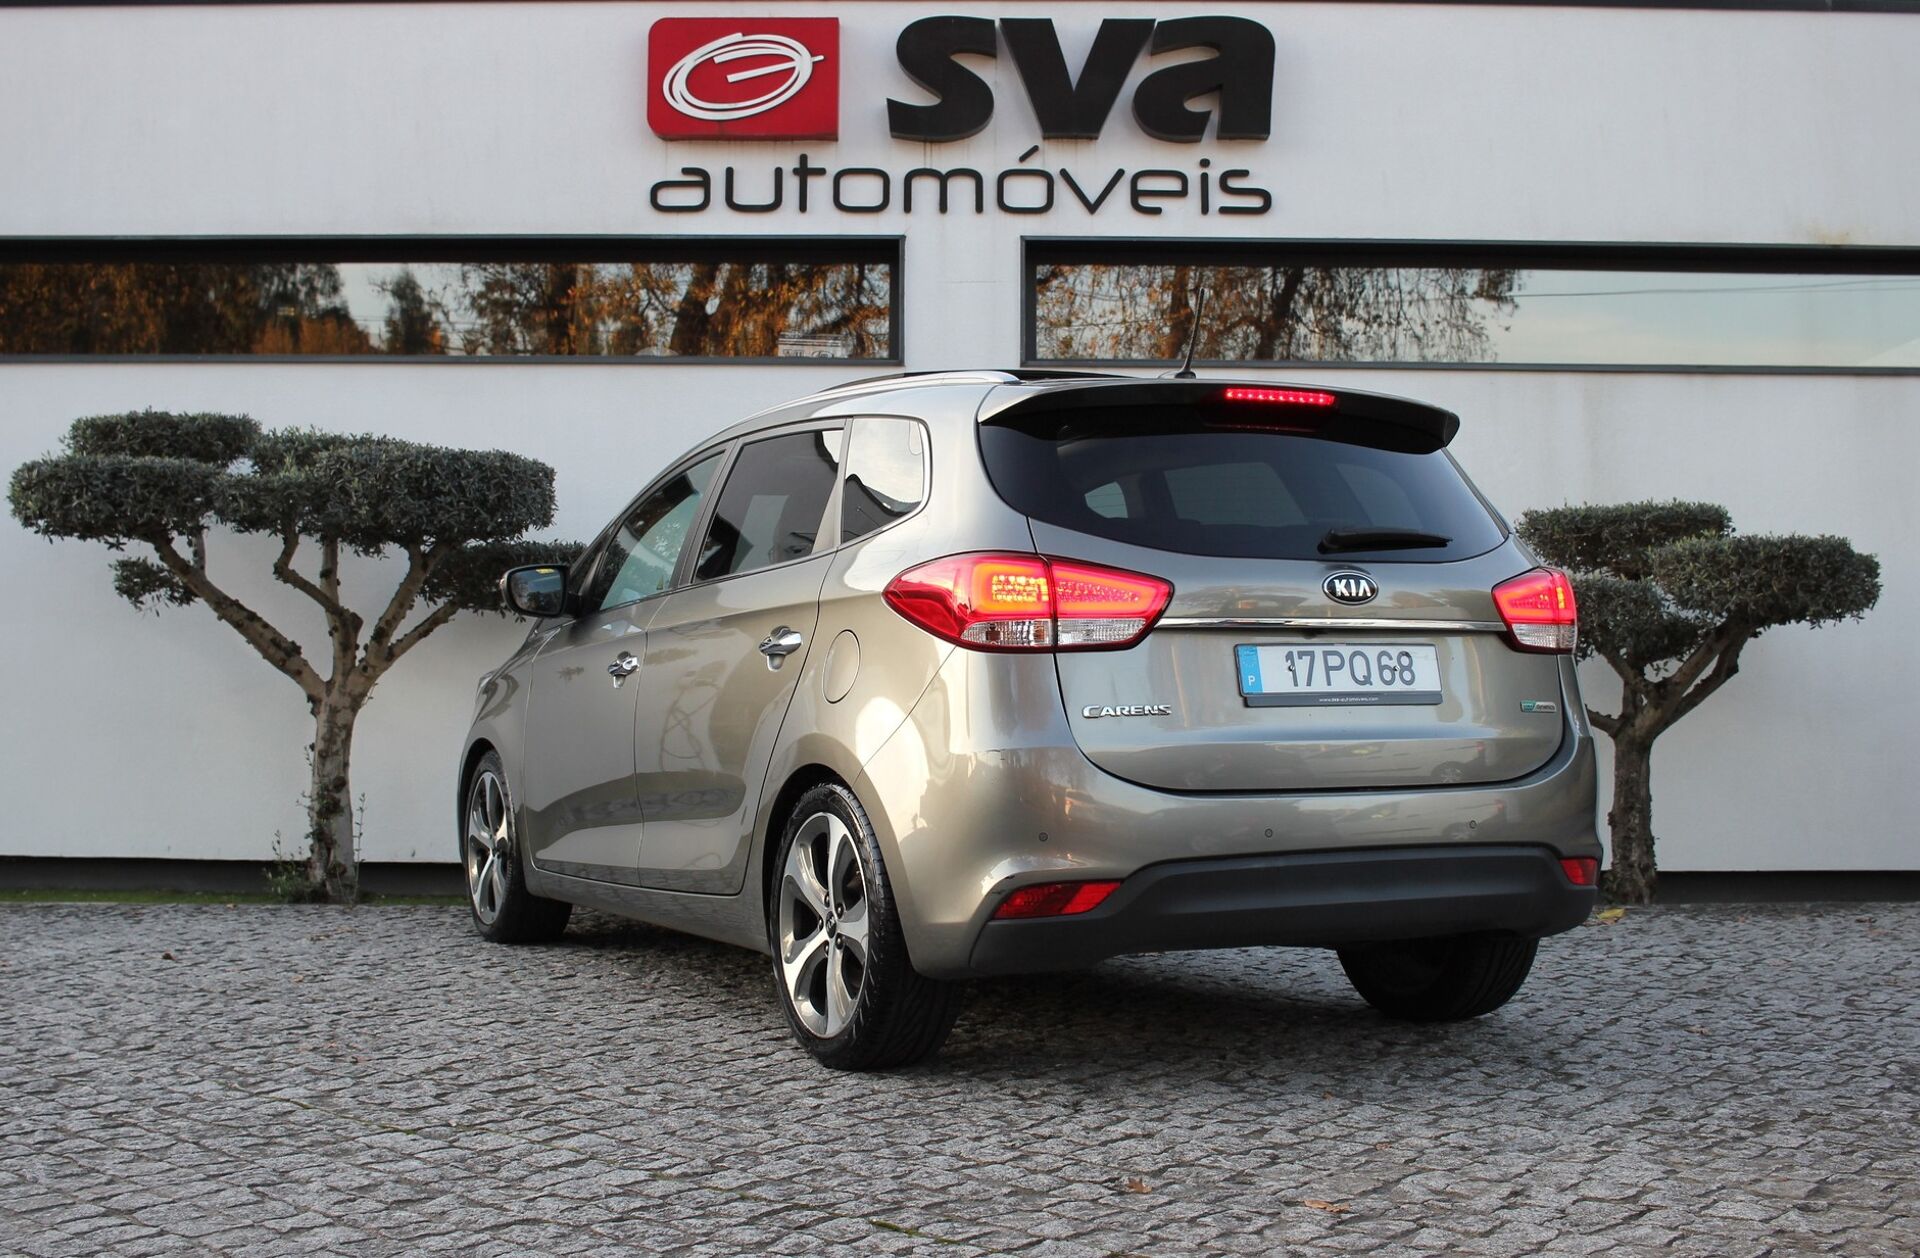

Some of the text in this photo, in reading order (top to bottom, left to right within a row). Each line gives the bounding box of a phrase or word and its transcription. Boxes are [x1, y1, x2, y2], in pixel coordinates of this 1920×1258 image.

[886, 15, 1276, 142] sva
[649, 145, 1273, 215] automóveis
[1333, 579, 1372, 597] KIA
[1082, 704, 1172, 718] CARENS
